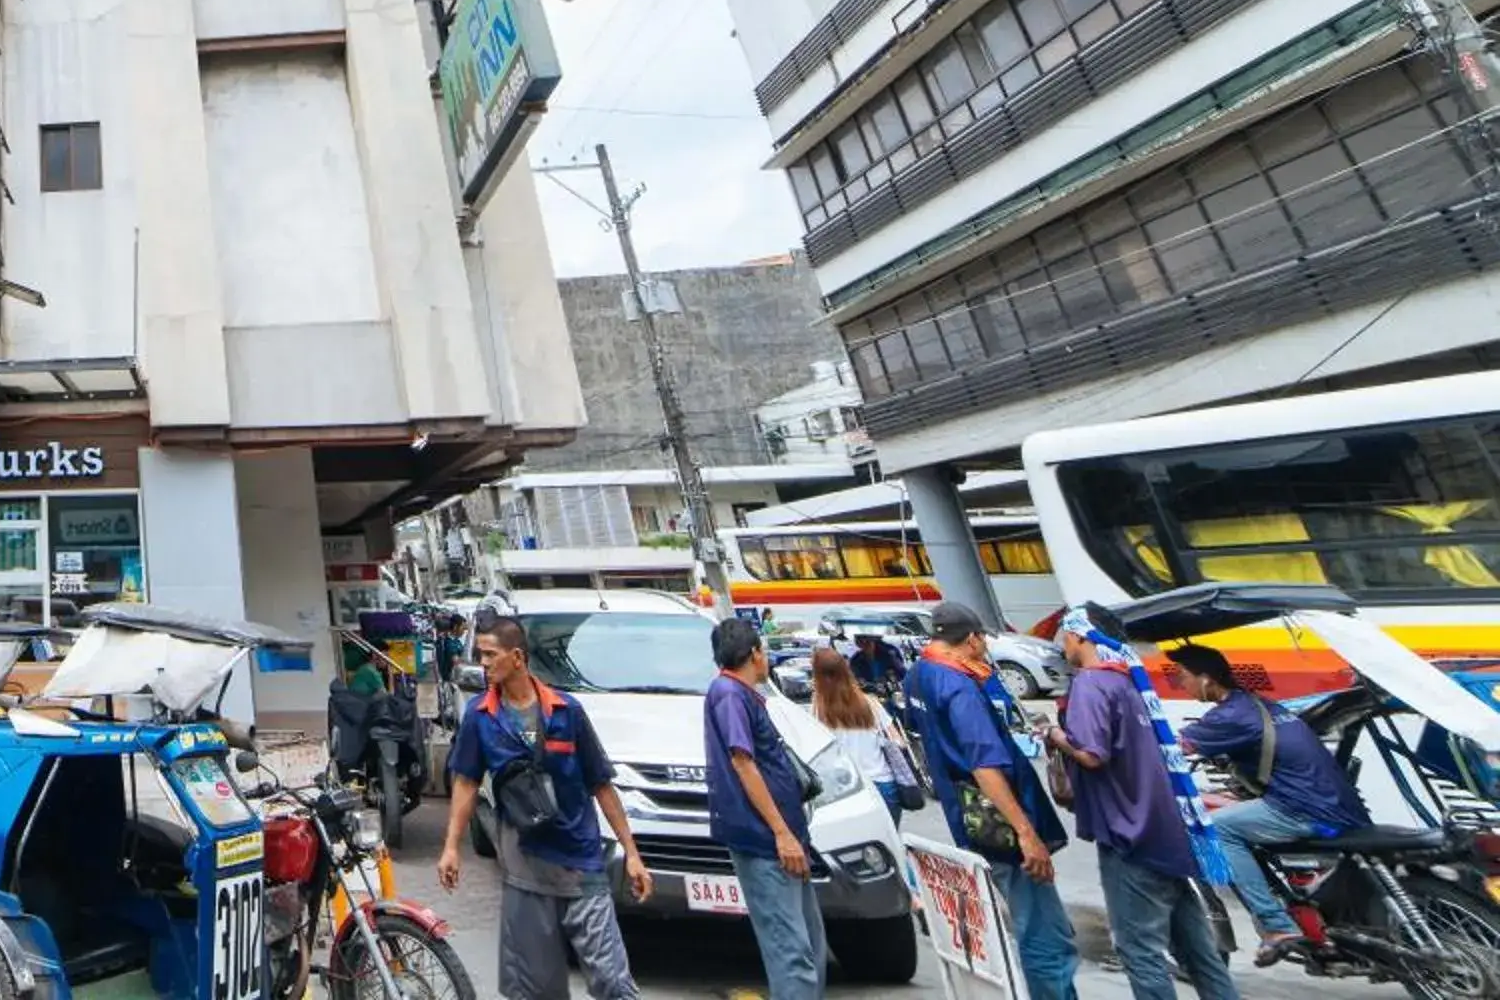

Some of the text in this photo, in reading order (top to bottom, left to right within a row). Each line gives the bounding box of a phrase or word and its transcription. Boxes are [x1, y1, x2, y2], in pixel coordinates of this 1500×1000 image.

[668, 766, 706, 781] ISU
[691, 881, 725, 903] SAA
[215, 878, 262, 1000] 3102
